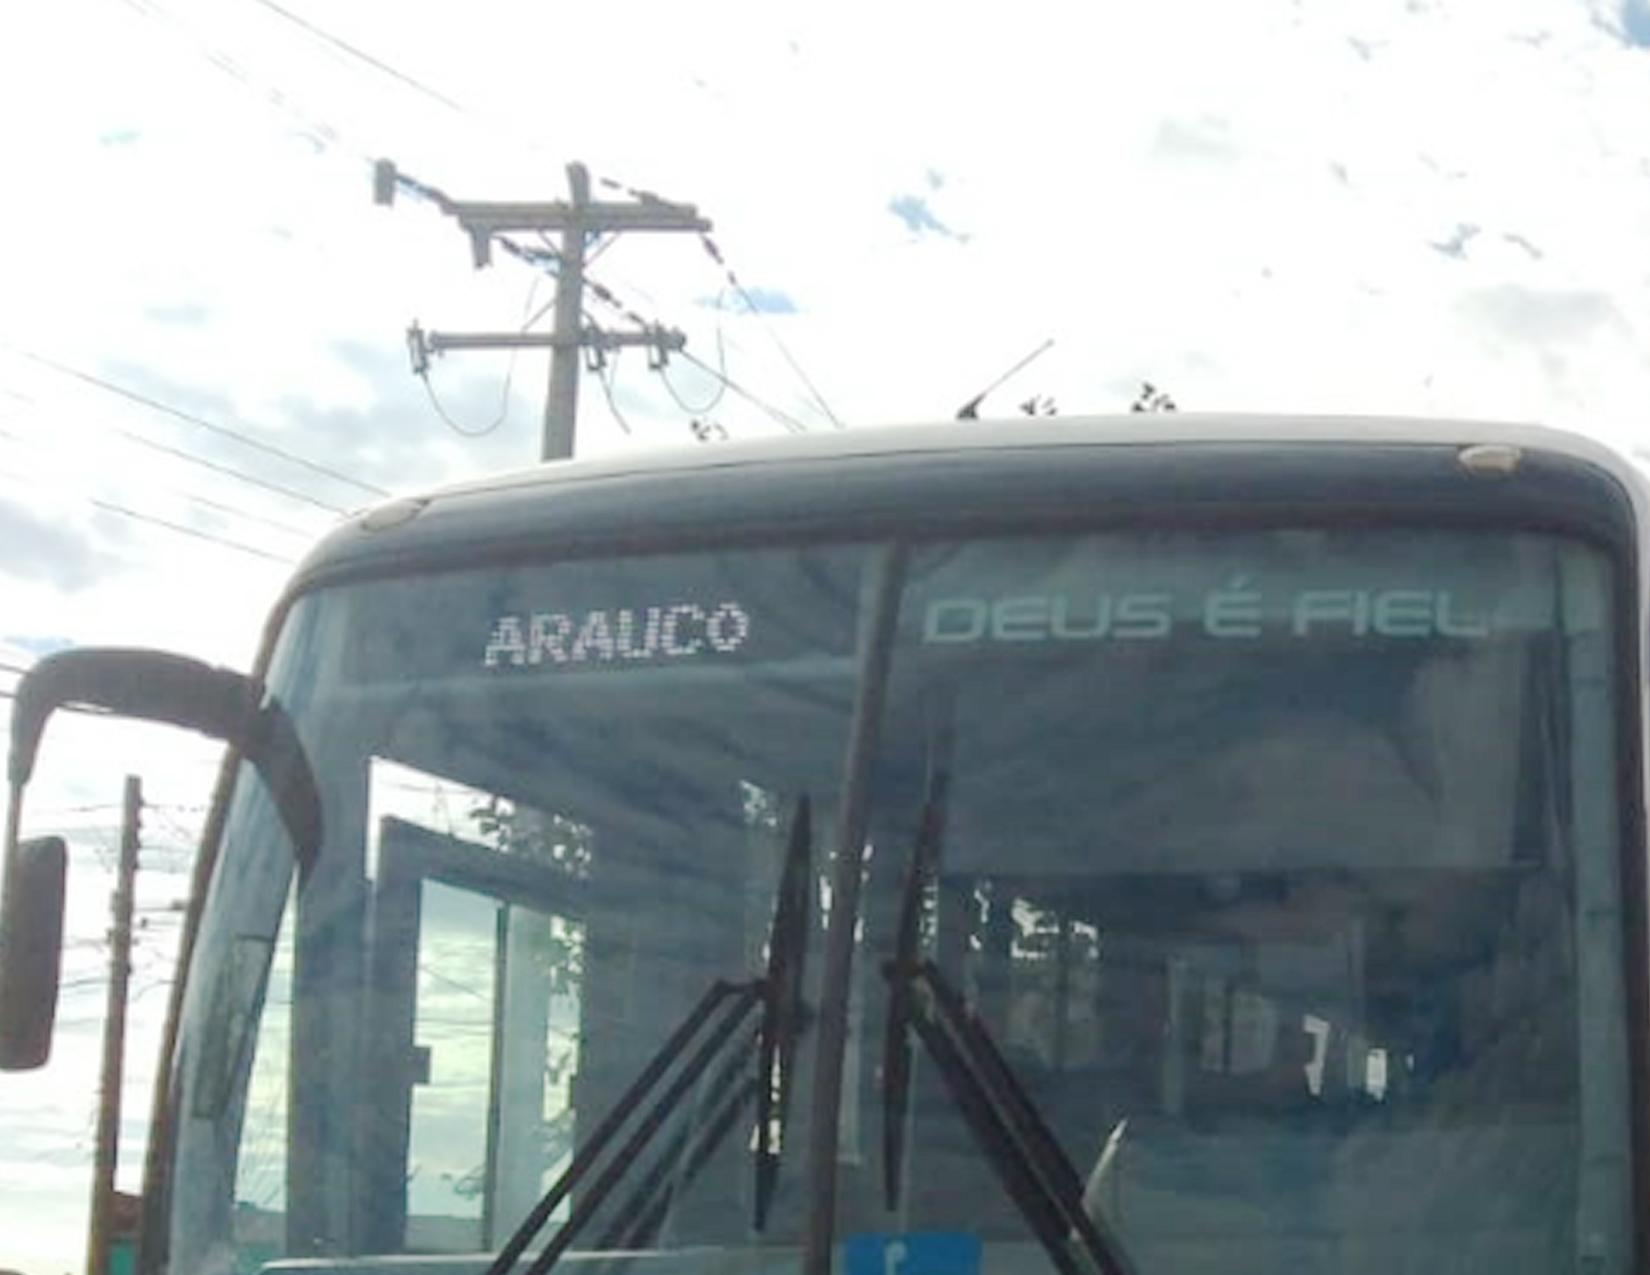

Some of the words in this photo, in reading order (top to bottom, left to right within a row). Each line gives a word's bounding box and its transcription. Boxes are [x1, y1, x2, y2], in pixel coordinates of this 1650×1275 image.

[922, 594, 1172, 643] DEUS
[1203, 575, 1262, 638] É
[1294, 590, 1488, 638] FIEL
